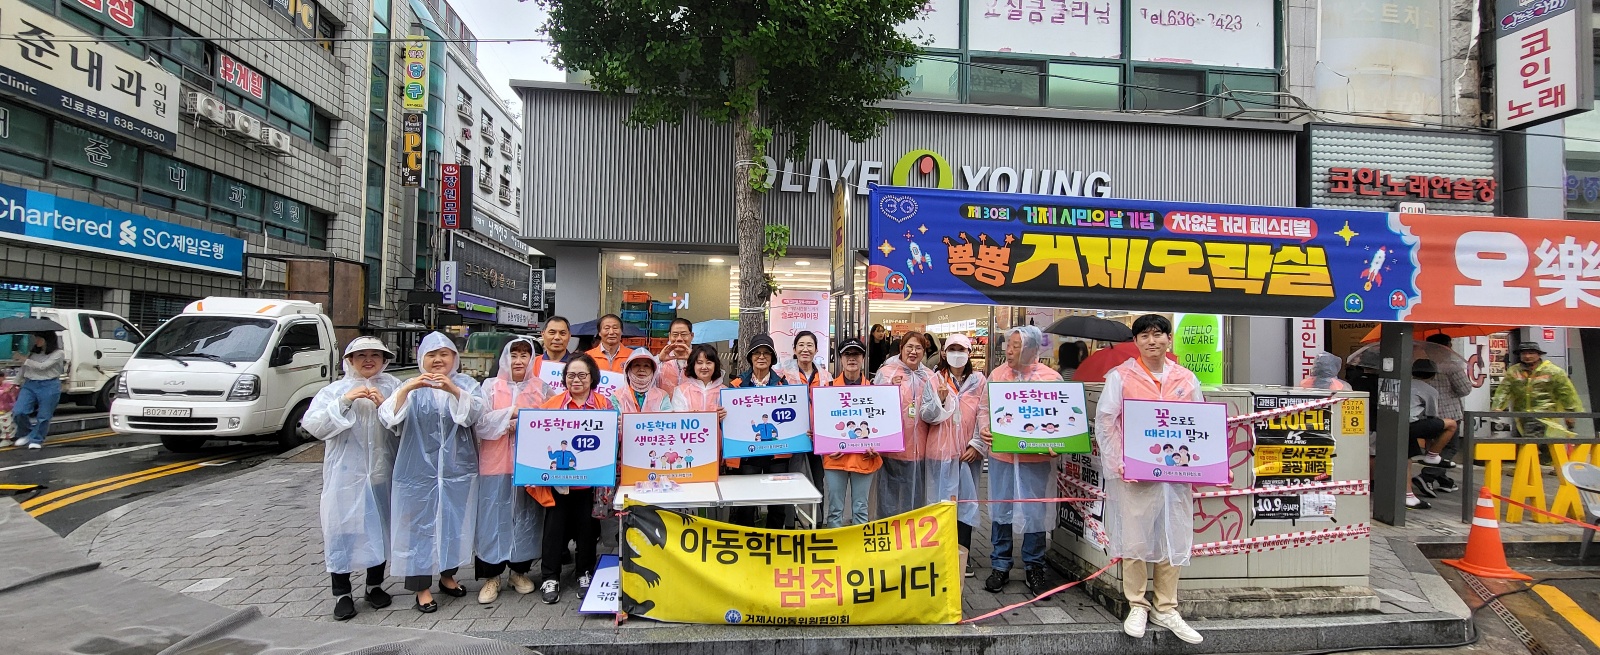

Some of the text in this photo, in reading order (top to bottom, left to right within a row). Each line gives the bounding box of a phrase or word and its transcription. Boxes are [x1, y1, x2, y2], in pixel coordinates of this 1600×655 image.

[0, 72, 38, 95] Clinic
[219, 54, 263, 100] 휴게텔
[408, 63, 424, 98] 당구
[1507, 84, 1566, 120] 노래
[60, 95, 165, 143] 진료문의 638-4830
[962, 165, 1112, 198] YOUNG
[1328, 167, 1497, 203] 코인노래연습장
[443, 176, 457, 226] 장원모텔
[967, 205, 982, 219] 제
[983, 207, 1010, 221] 30회
[1023, 206, 1056, 224] 거제
[1127, 211, 1155, 230] 기념
[1171, 213, 1217, 232] 차없는
[1219, 216, 1247, 233] 거리
[1250, 217, 1311, 238] 페스티벌
[142, 228, 225, 260] SC제일은행
[1011, 233, 1335, 297] 거제오락실
[443, 284, 452, 300] CU
[781, 311, 818, 320] 슬로우에이징
[1183, 325, 1213, 335] HELLO
[1339, 322, 1375, 330] NOREABANG
[1182, 335, 1214, 345] WE ARE
[1185, 353, 1211, 362] OLIVE
[600, 375, 609, 385] O
[732, 393, 798, 407] 아동학대신고
[838, 392, 875, 408] 꽃으로도
[1005, 389, 1070, 404] 아동학대는
[774, 410, 792, 421] 112
[830, 407, 886, 419] 때리지 말자
[1018, 405, 1059, 419] 범죄다
[1154, 408, 1196, 428] 꽃으로도
[529, 418, 604, 432] 아동학대신고
[635, 418, 700, 431] 아동학대 NO
[1350, 416, 1359, 428] 8
[634, 432, 705, 446] 생명존중 YES
[1144, 428, 1210, 441] 때리지 말자
[576, 437, 595, 449] 112
[1281, 448, 1304, 459] 본사
[1305, 461, 1327, 474] 폐점
[863, 521, 890, 537] 신고
[863, 515, 939, 553] 전화 112
[680, 527, 838, 564] 아동학대는
[773, 562, 948, 608] 범죄입니다.
[745, 614, 850, 625] 거제시아동위원협의회
